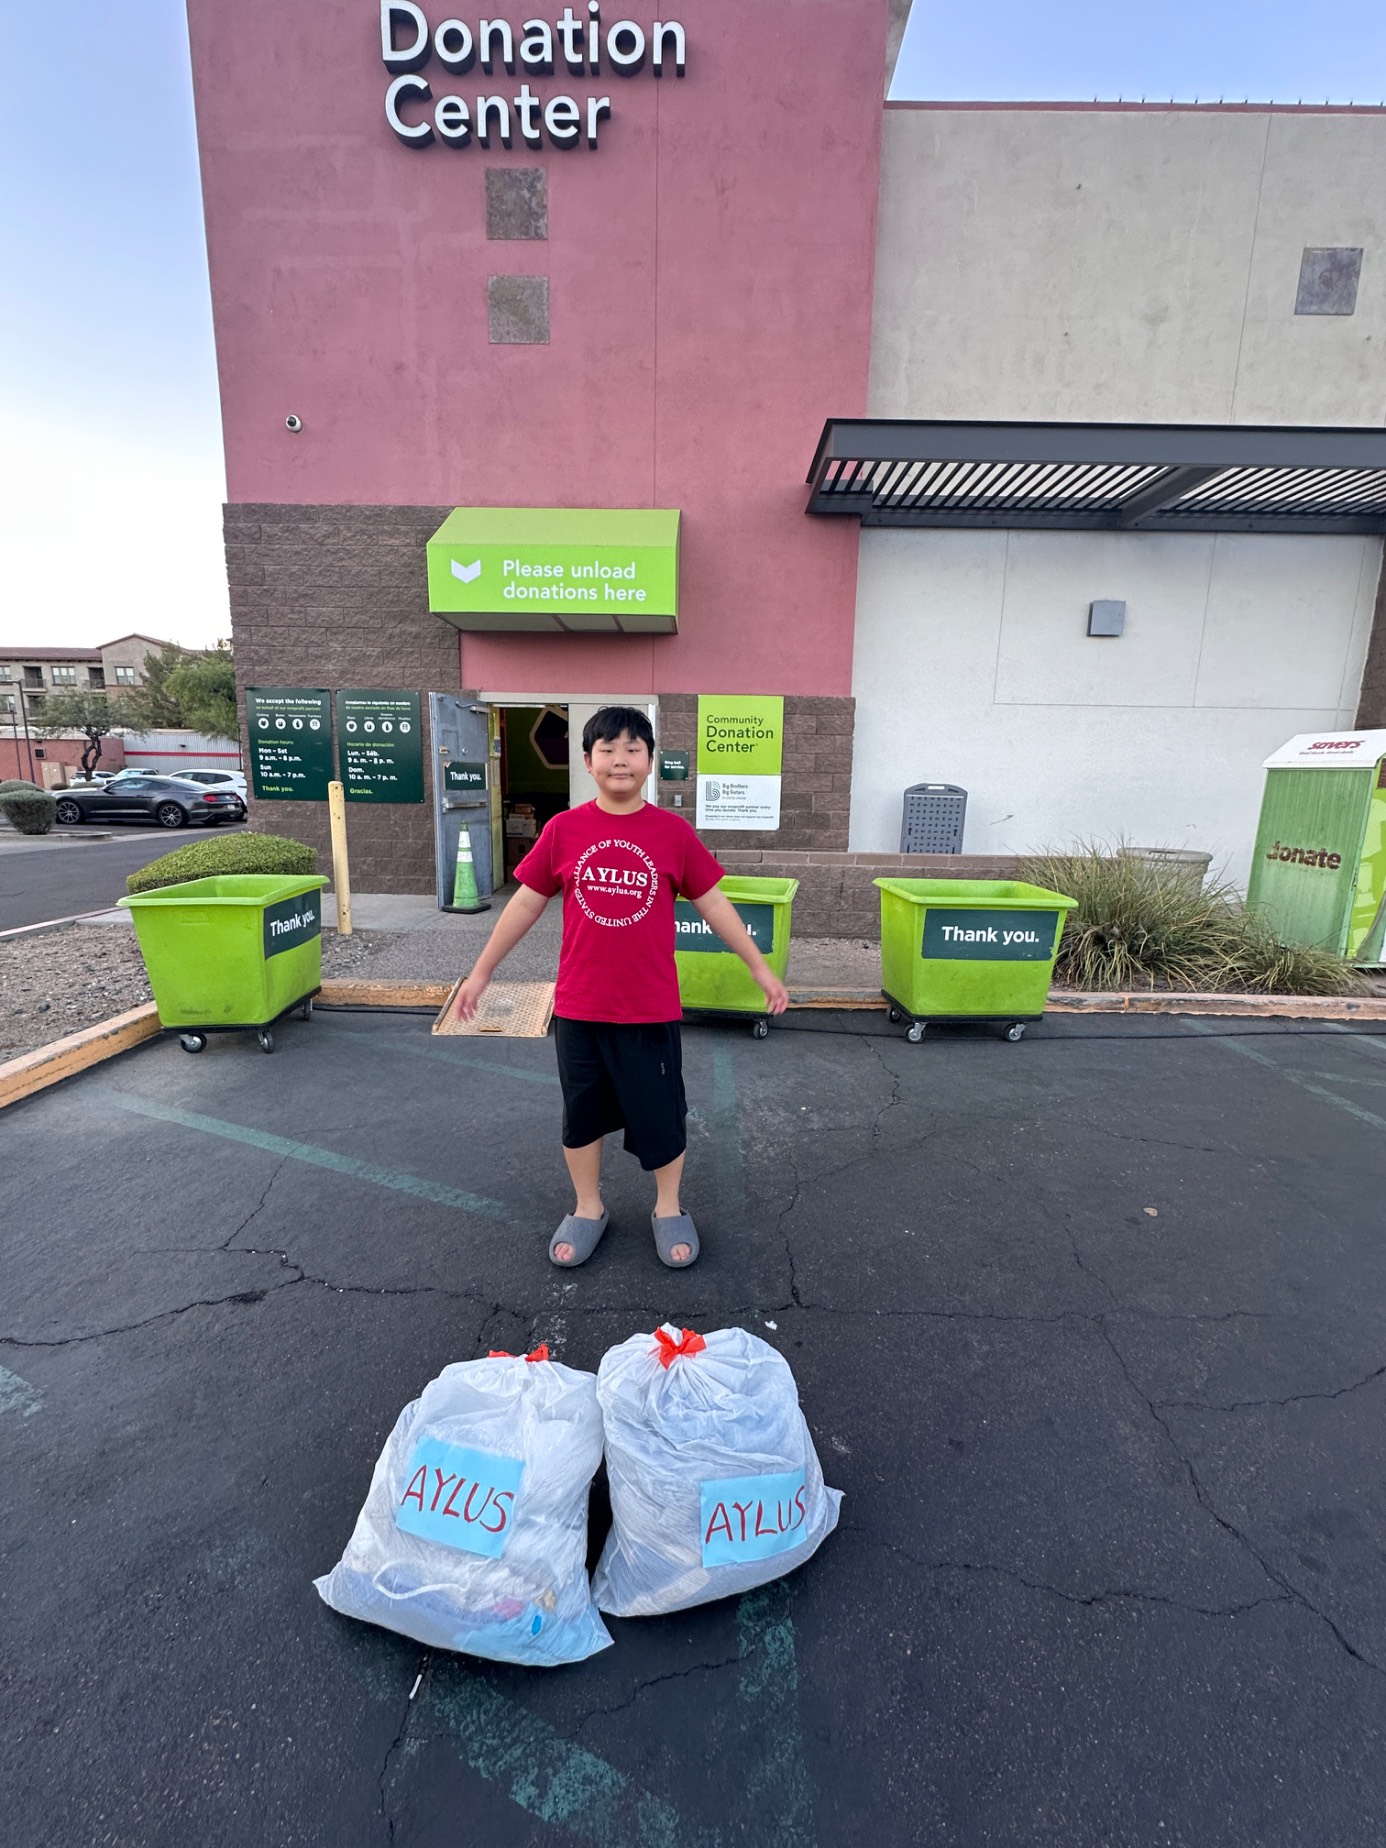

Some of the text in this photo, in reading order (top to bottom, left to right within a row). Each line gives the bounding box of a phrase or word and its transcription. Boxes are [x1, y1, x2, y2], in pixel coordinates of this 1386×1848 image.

[380, 0, 687, 70] Donation
[385, 74, 611, 141] Center
[503, 560, 636, 580] Please unload
[503, 581, 647, 602] donations here
[706, 714, 764, 727] Community
[706, 725, 774, 739] Donation
[706, 740, 755, 753] Center
[1307, 740, 1366, 750] savers
[450, 771, 482, 782] Thank you.
[598, 839, 612, 849] OF
[613, 839, 646, 859] YOUTH
[581, 866, 648, 887] AYLUS
[642, 855, 659, 896] LEADERS
[587, 884, 643, 899] www.aylus.org
[574, 888, 595, 919] STATES
[645, 896, 654, 908] IN
[270, 910, 316, 937] Thank you.
[594, 915, 632, 927] UNITED
[631, 906, 649, 922] THE
[941, 926, 1040, 945] Thank you.
[400, 1464, 514, 1533] AYLUS
[705, 1485, 806, 1545] AYLUS
